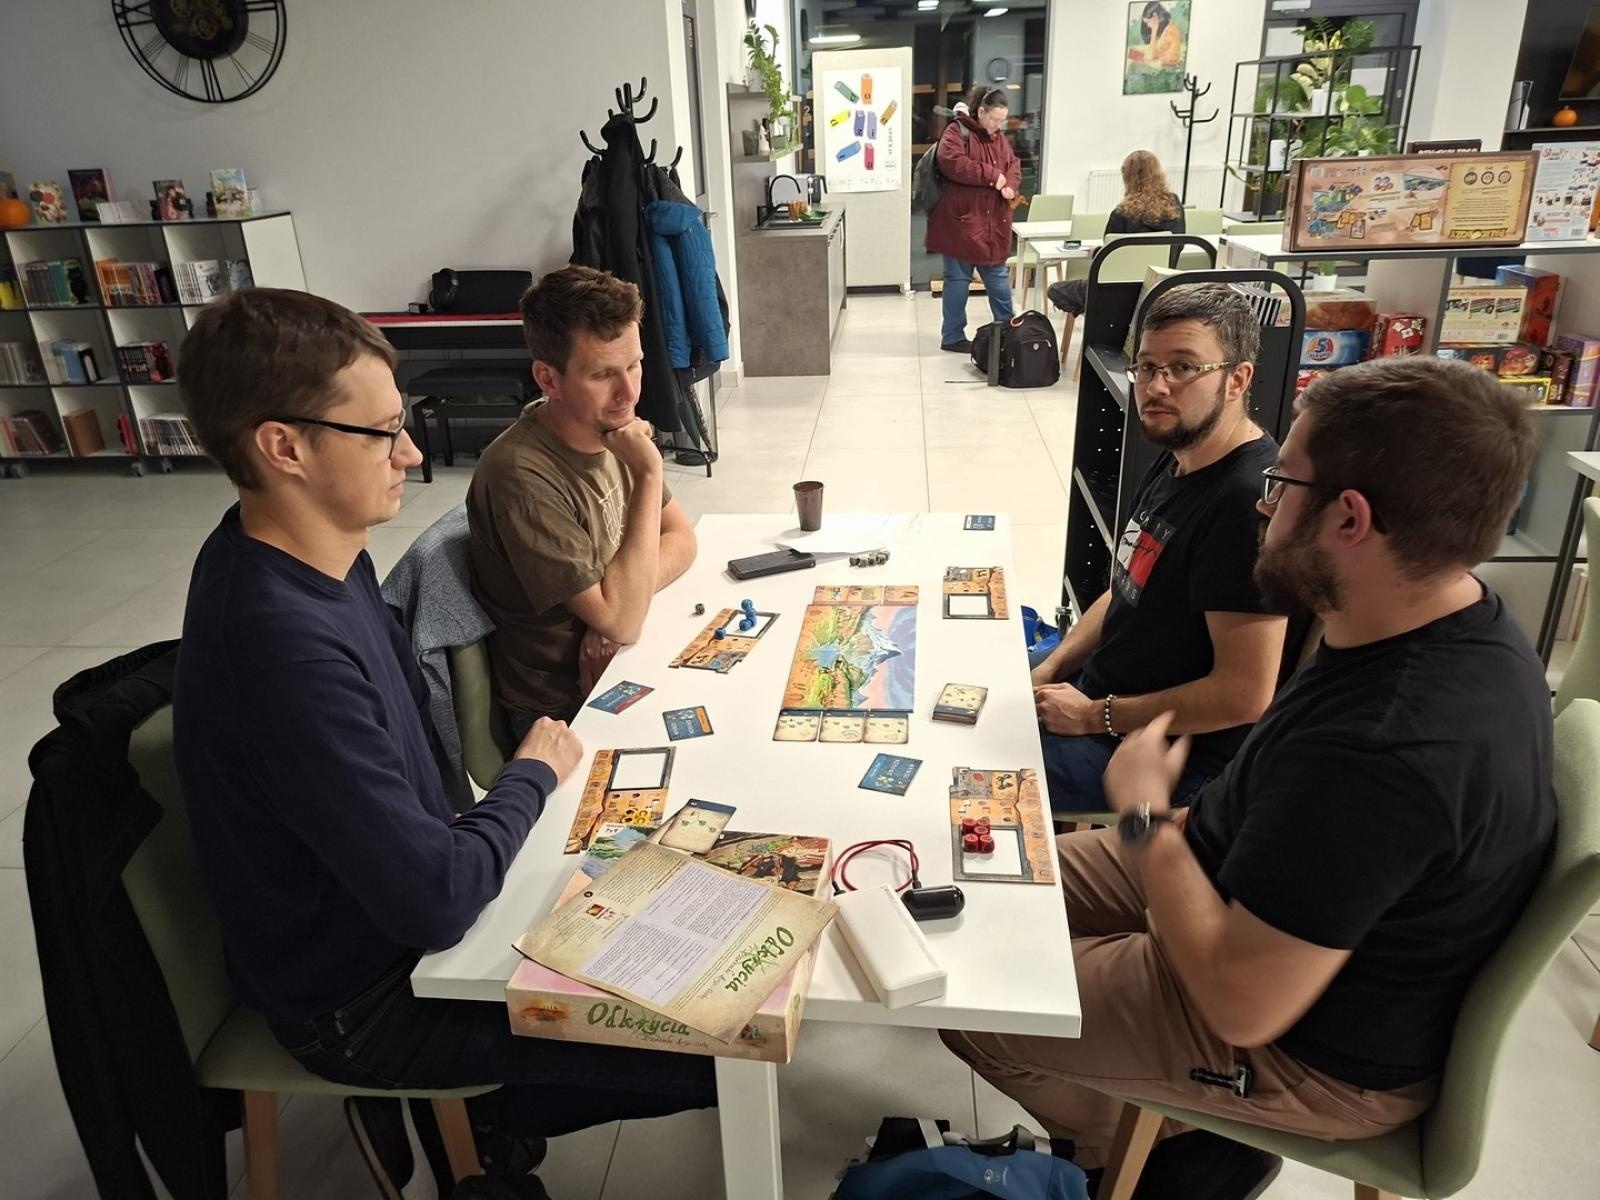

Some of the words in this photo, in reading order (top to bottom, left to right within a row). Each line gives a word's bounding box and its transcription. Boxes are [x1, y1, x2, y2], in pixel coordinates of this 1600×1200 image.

[1315, 337, 1328, 353] 5
[723, 925, 795, 993] Odkrycia
[587, 1000, 690, 1036] Odkrycia
